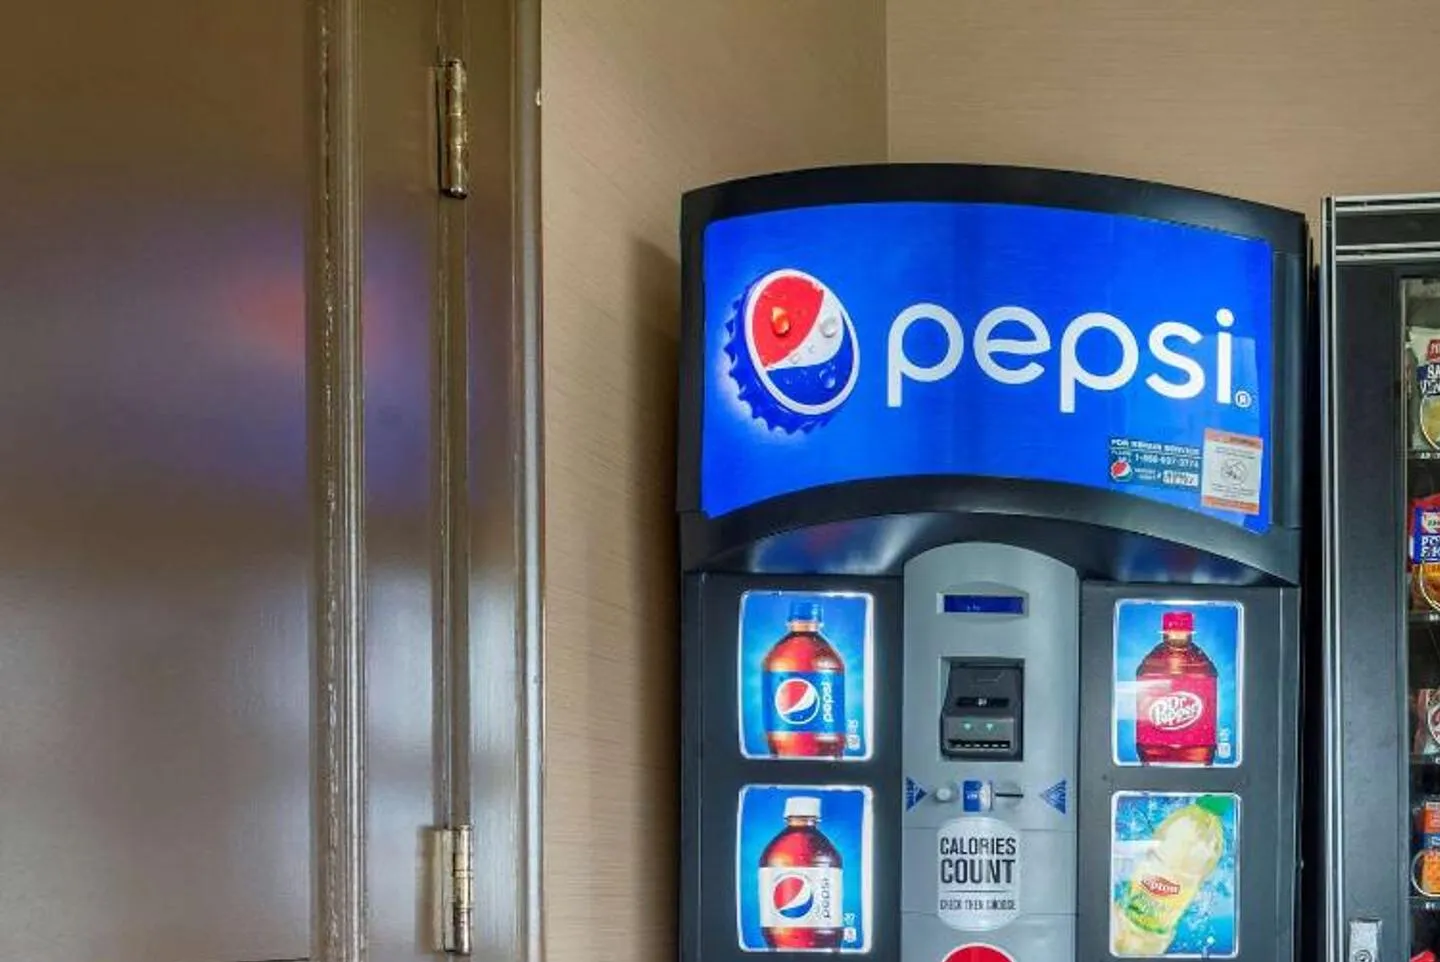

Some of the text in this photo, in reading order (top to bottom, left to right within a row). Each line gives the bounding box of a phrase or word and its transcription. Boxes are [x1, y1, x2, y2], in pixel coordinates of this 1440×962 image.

[887, 303, 1235, 413] pepsi
[940, 837, 1016, 855] CALORIES
[940, 859, 1016, 884] COUNT
